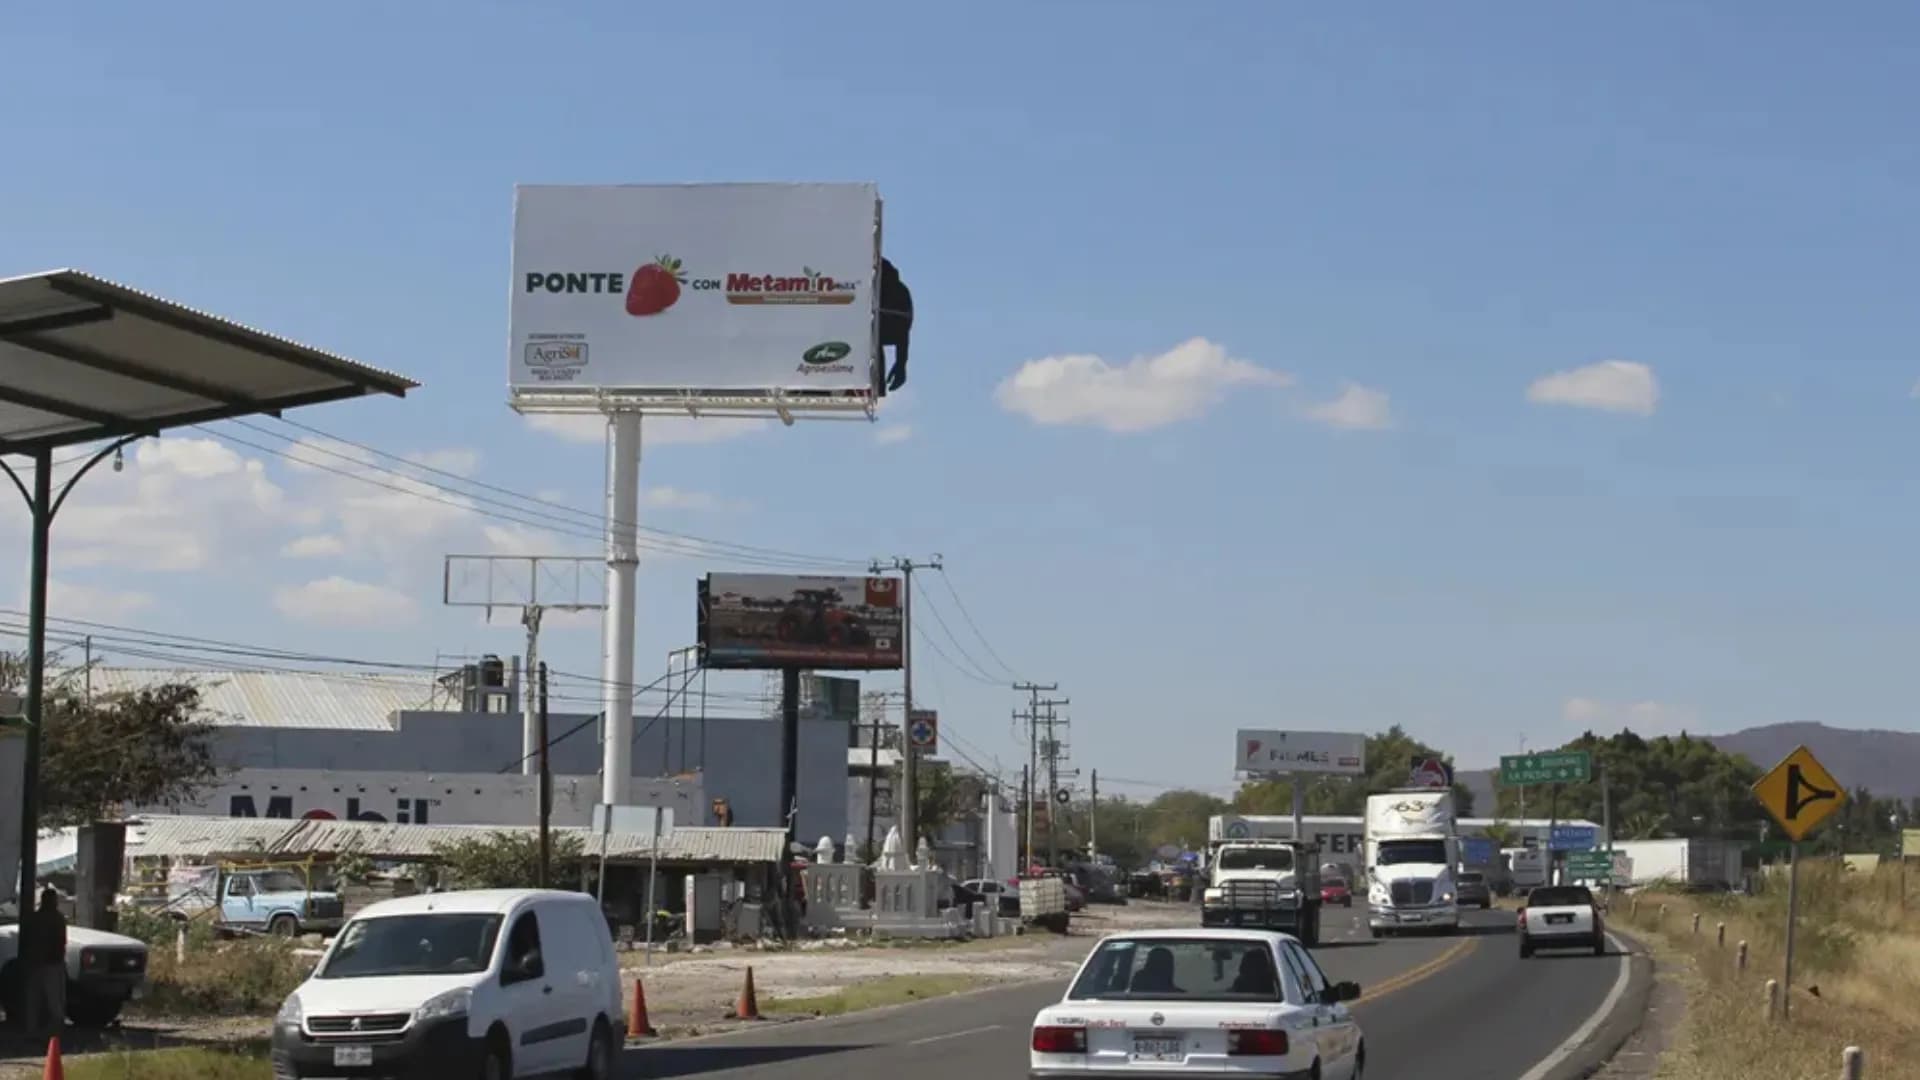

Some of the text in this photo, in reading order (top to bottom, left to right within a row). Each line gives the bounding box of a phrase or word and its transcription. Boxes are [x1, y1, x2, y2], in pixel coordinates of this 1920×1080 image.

[526, 272, 624, 294] PONTE
[692, 279, 721, 290] CON
[726, 267, 834, 293] Metamin
[230, 795, 428, 824] Mbil
